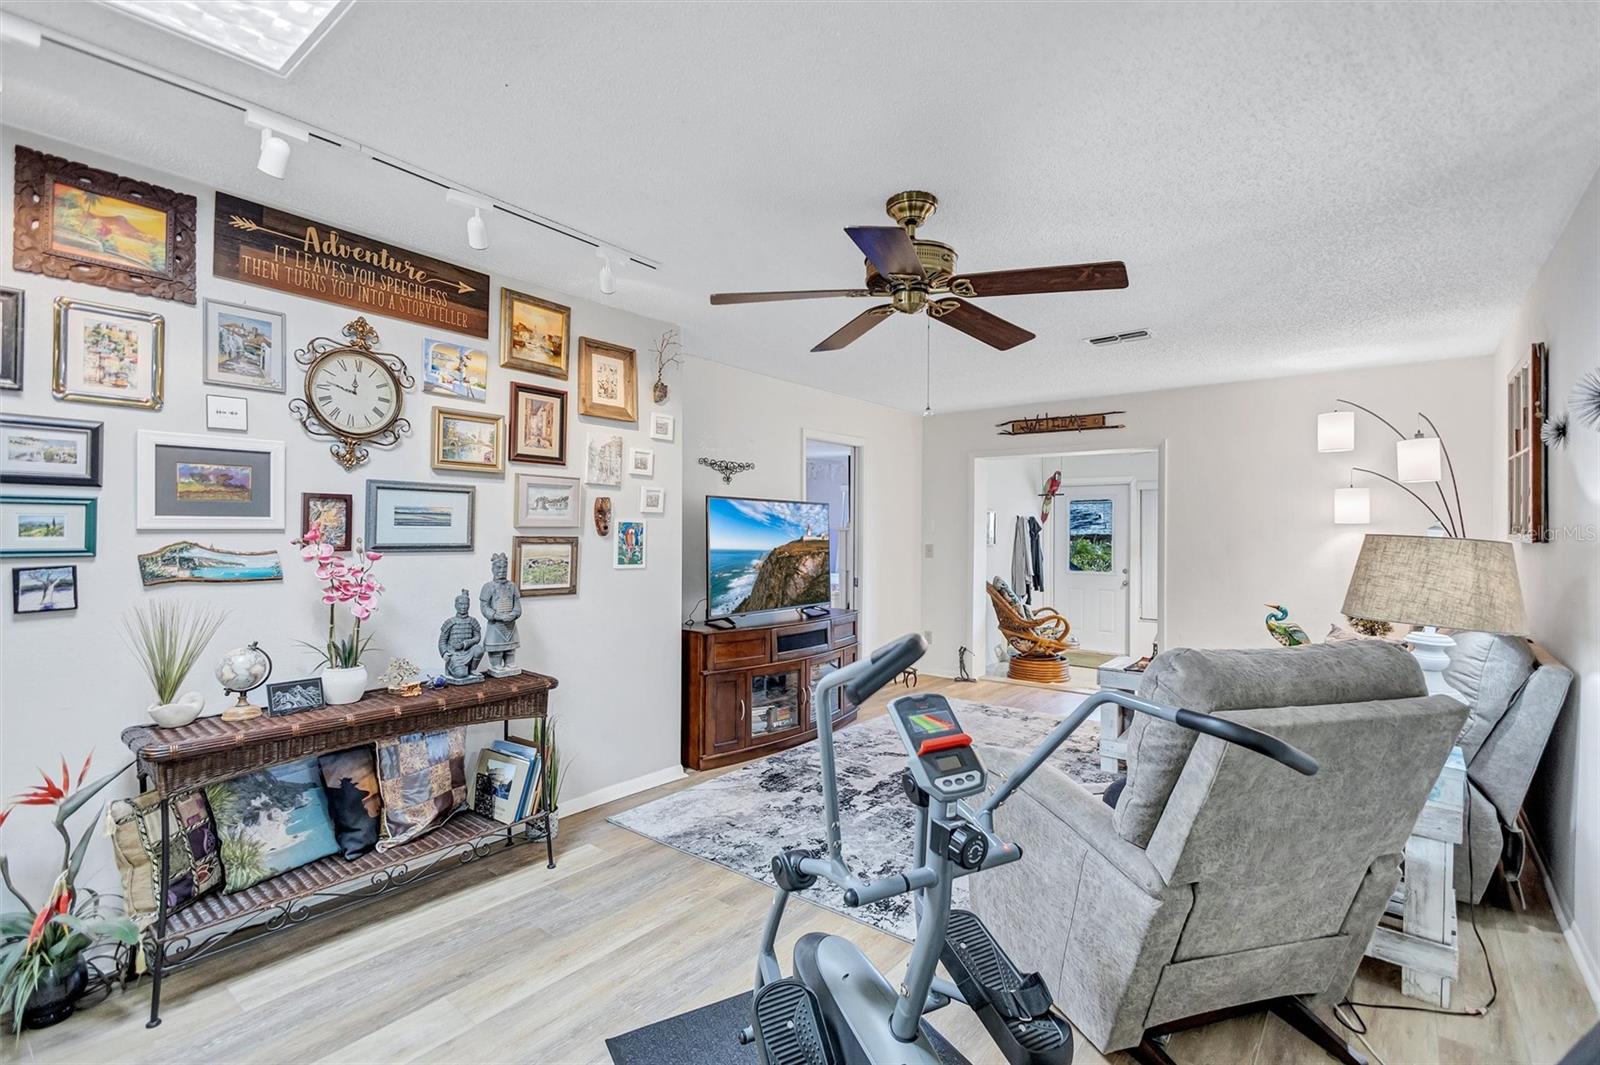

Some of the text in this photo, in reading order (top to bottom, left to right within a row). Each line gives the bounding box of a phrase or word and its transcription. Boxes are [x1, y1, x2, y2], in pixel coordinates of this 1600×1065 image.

[274, 244, 448, 307] IT LEAVES YOU SPEECHLESS
[303, 225, 428, 284] Adventure
[241, 255, 469, 329] THEN TURNS YOU INTO A STORYTELLER
[1024, 412, 1088, 432] WELCOME
